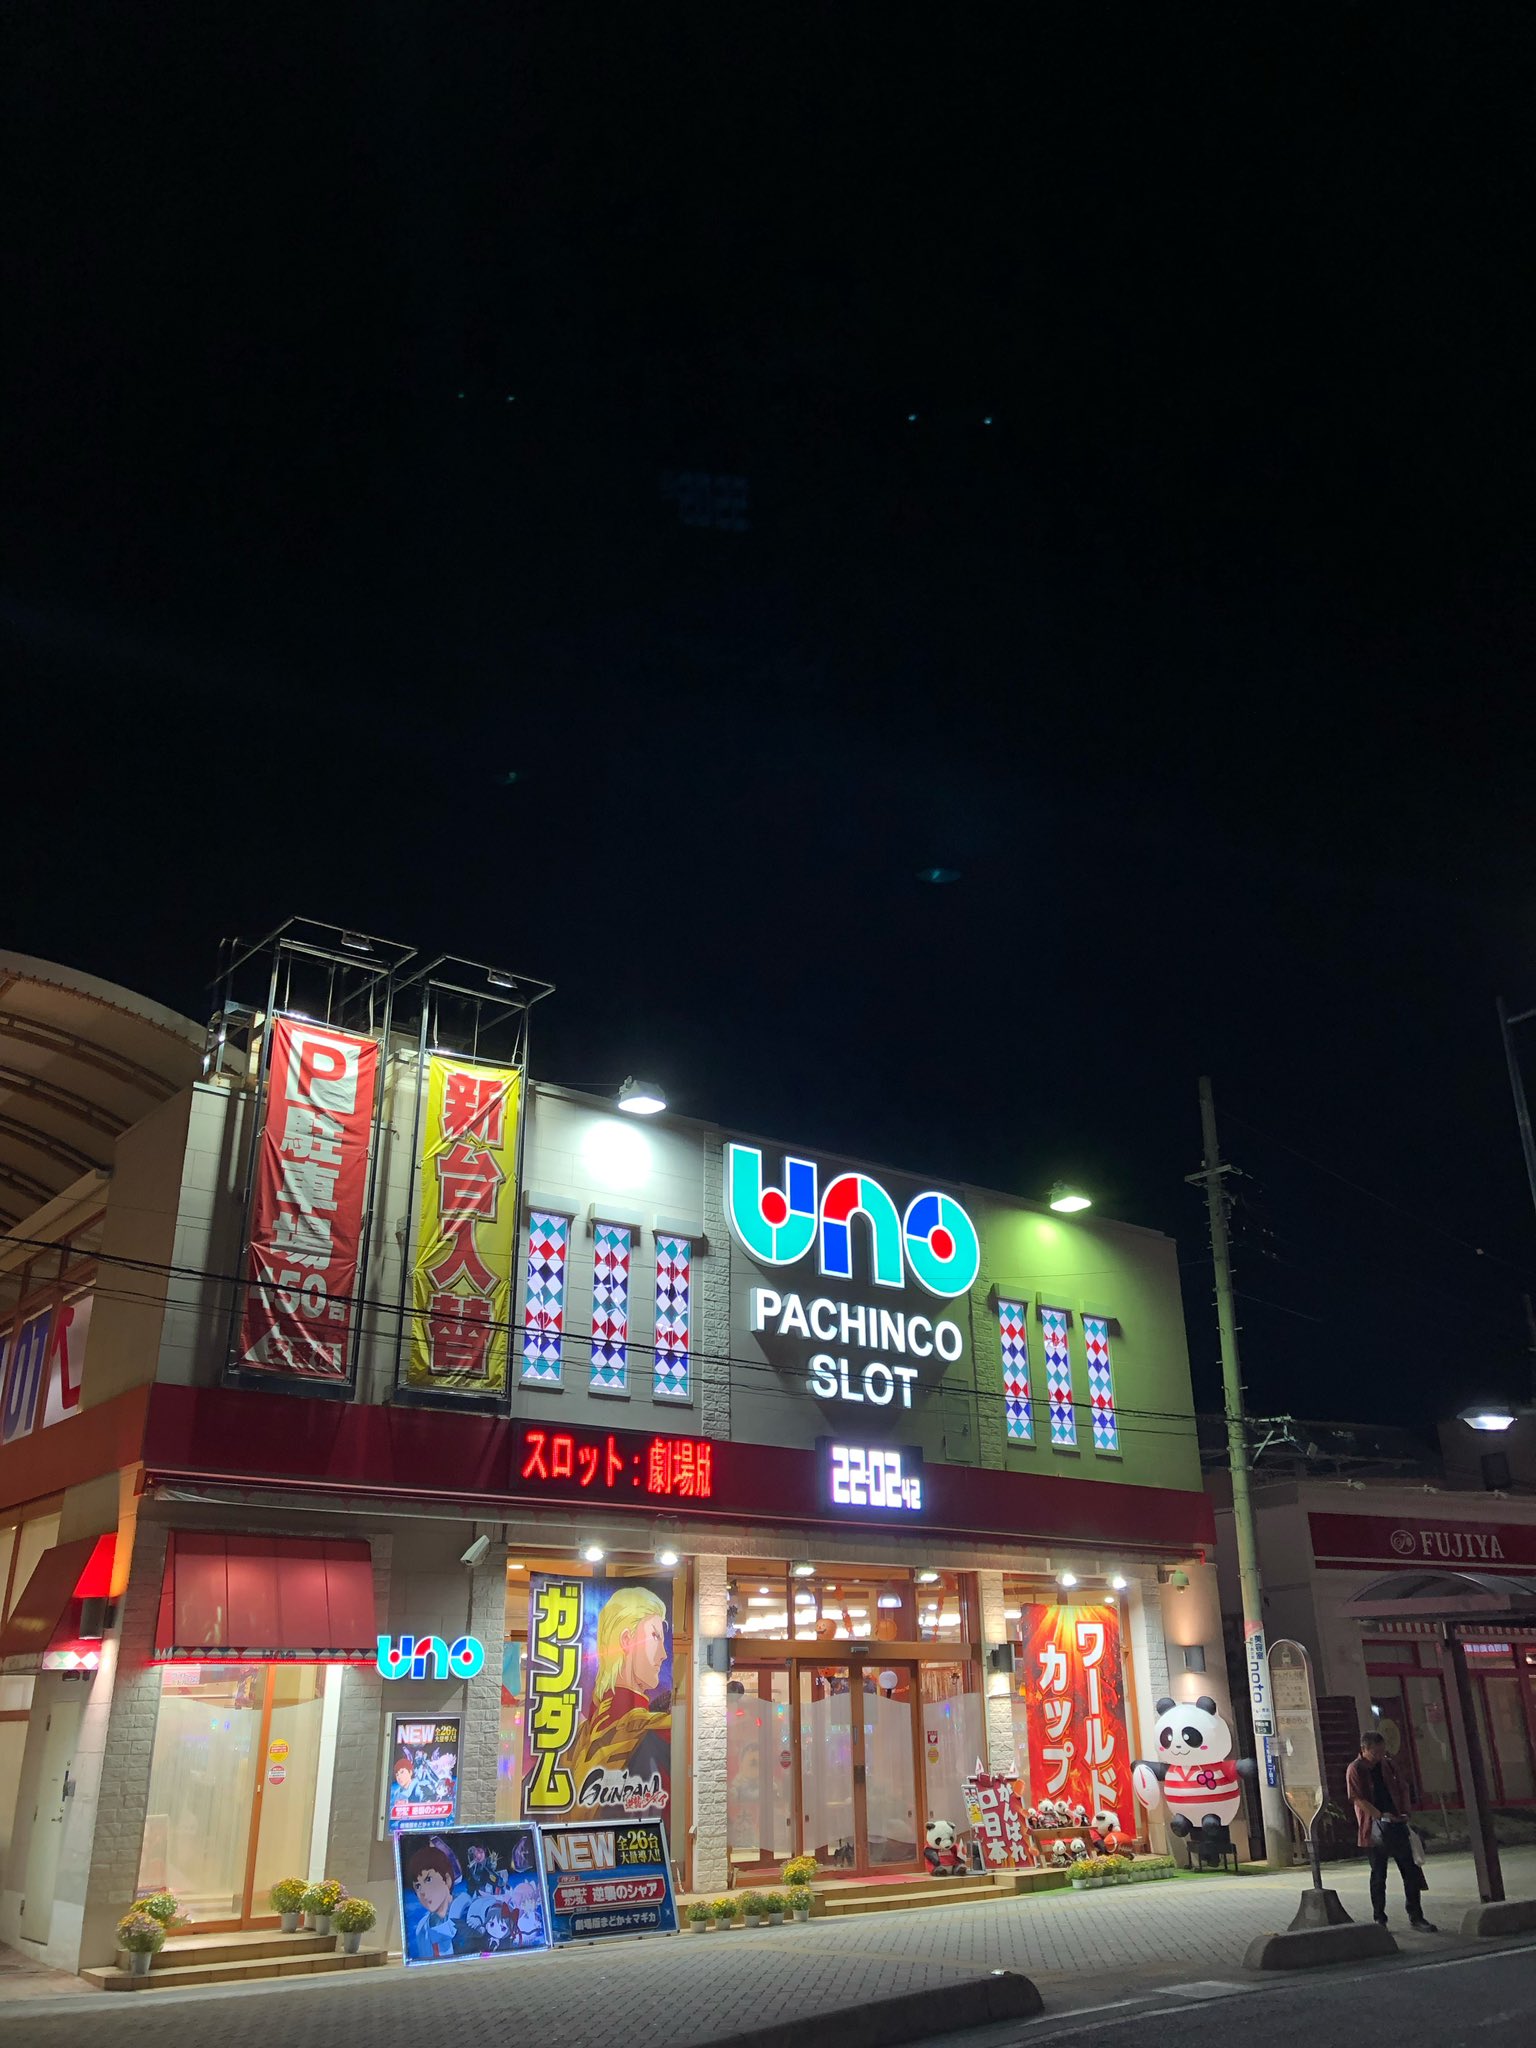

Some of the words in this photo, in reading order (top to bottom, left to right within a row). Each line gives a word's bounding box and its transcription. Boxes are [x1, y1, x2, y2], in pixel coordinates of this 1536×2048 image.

[297, 1040, 347, 1097] P
[269, 1105, 345, 1271] 駐車場
[427, 1072, 506, 1376] 新台入替
[751, 1286, 964, 1362] PACHINCO
[806, 1353, 918, 1409] SLOT
[832, 1446, 902, 1508] 22:02
[902, 1478, 921, 1510] 42
[1420, 1531, 1505, 1559] FUJIYA
[528, 1584, 581, 1810] ガンダム
[1250, 1661, 1264, 1704] noto
[397, 1724, 436, 1744] NEW
[1039, 1644, 1075, 1795] カップ
[1076, 1623, 1117, 1816] ワールド
[542, 1831, 617, 1873] NEW
[617, 1830, 659, 1851] 全26台
[592, 1882, 658, 1902] 逆襲のシャア
